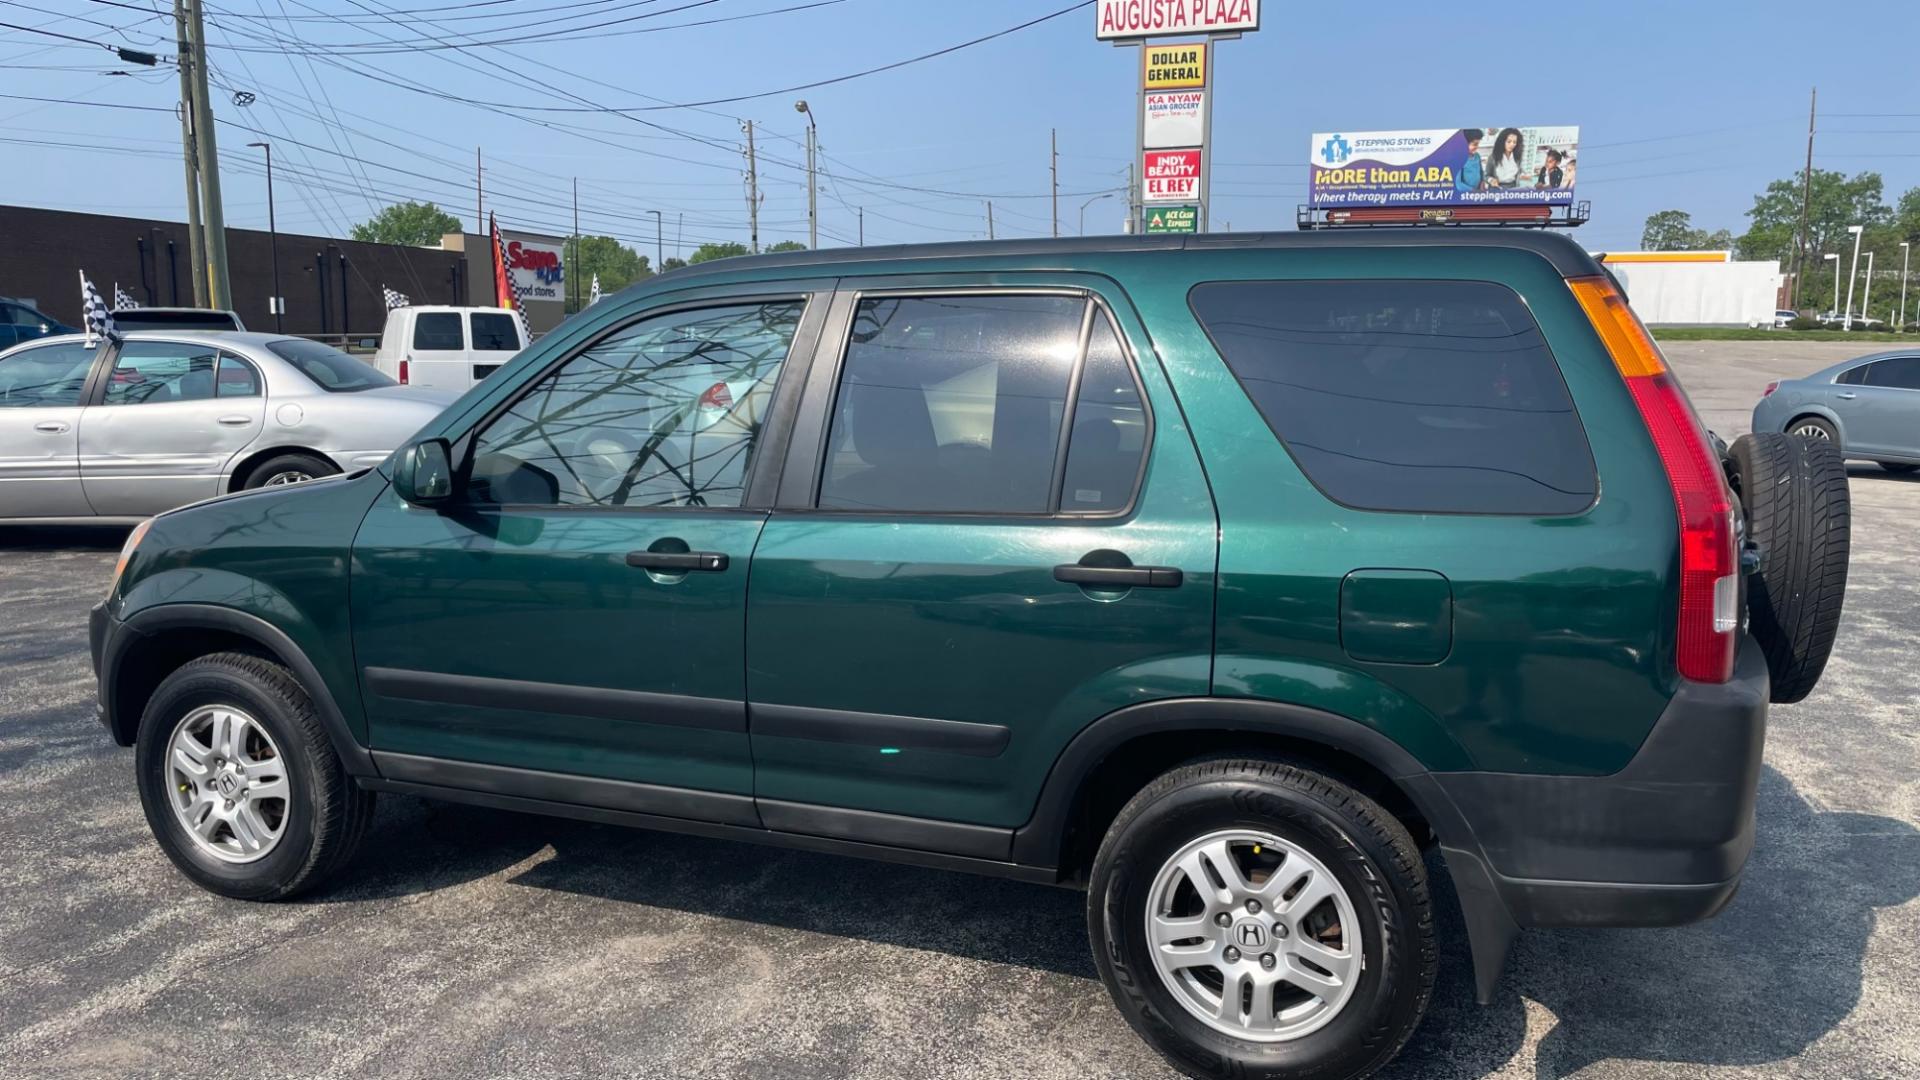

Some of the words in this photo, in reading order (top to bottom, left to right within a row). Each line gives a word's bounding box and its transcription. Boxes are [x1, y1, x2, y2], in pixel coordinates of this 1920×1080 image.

[1102, 0, 1186, 32] AUGUSTA
[1193, 0, 1252, 26] PLAZA
[1152, 51, 1197, 65] DOLLAR
[1148, 67, 1200, 81] GENERAL
[1148, 96, 1165, 104] KA
[1167, 94, 1202, 104] NYAW
[1169, 102, 1200, 111] GROCERY
[1354, 138, 1397, 147] STEPPING
[1397, 137, 1432, 146] STONES
[1157, 155, 1187, 166] INDY
[1148, 165, 1196, 177] BEAUTY
[1315, 169, 1366, 184] MORE
[1370, 167, 1410, 183] than
[1413, 166, 1453, 182] ABA
[1148, 179, 1164, 193] EL
[1167, 178, 1194, 193] REY
[1314, 193, 1346, 203] Where
[1347, 191, 1388, 204] therapy
[1389, 190, 1421, 201] meets
[1422, 189, 1454, 201] PLAY!
[1460, 190, 1573, 203] steppingstonesindy.com
[517, 284, 534, 298] ood
[534, 286, 556, 298] stores
